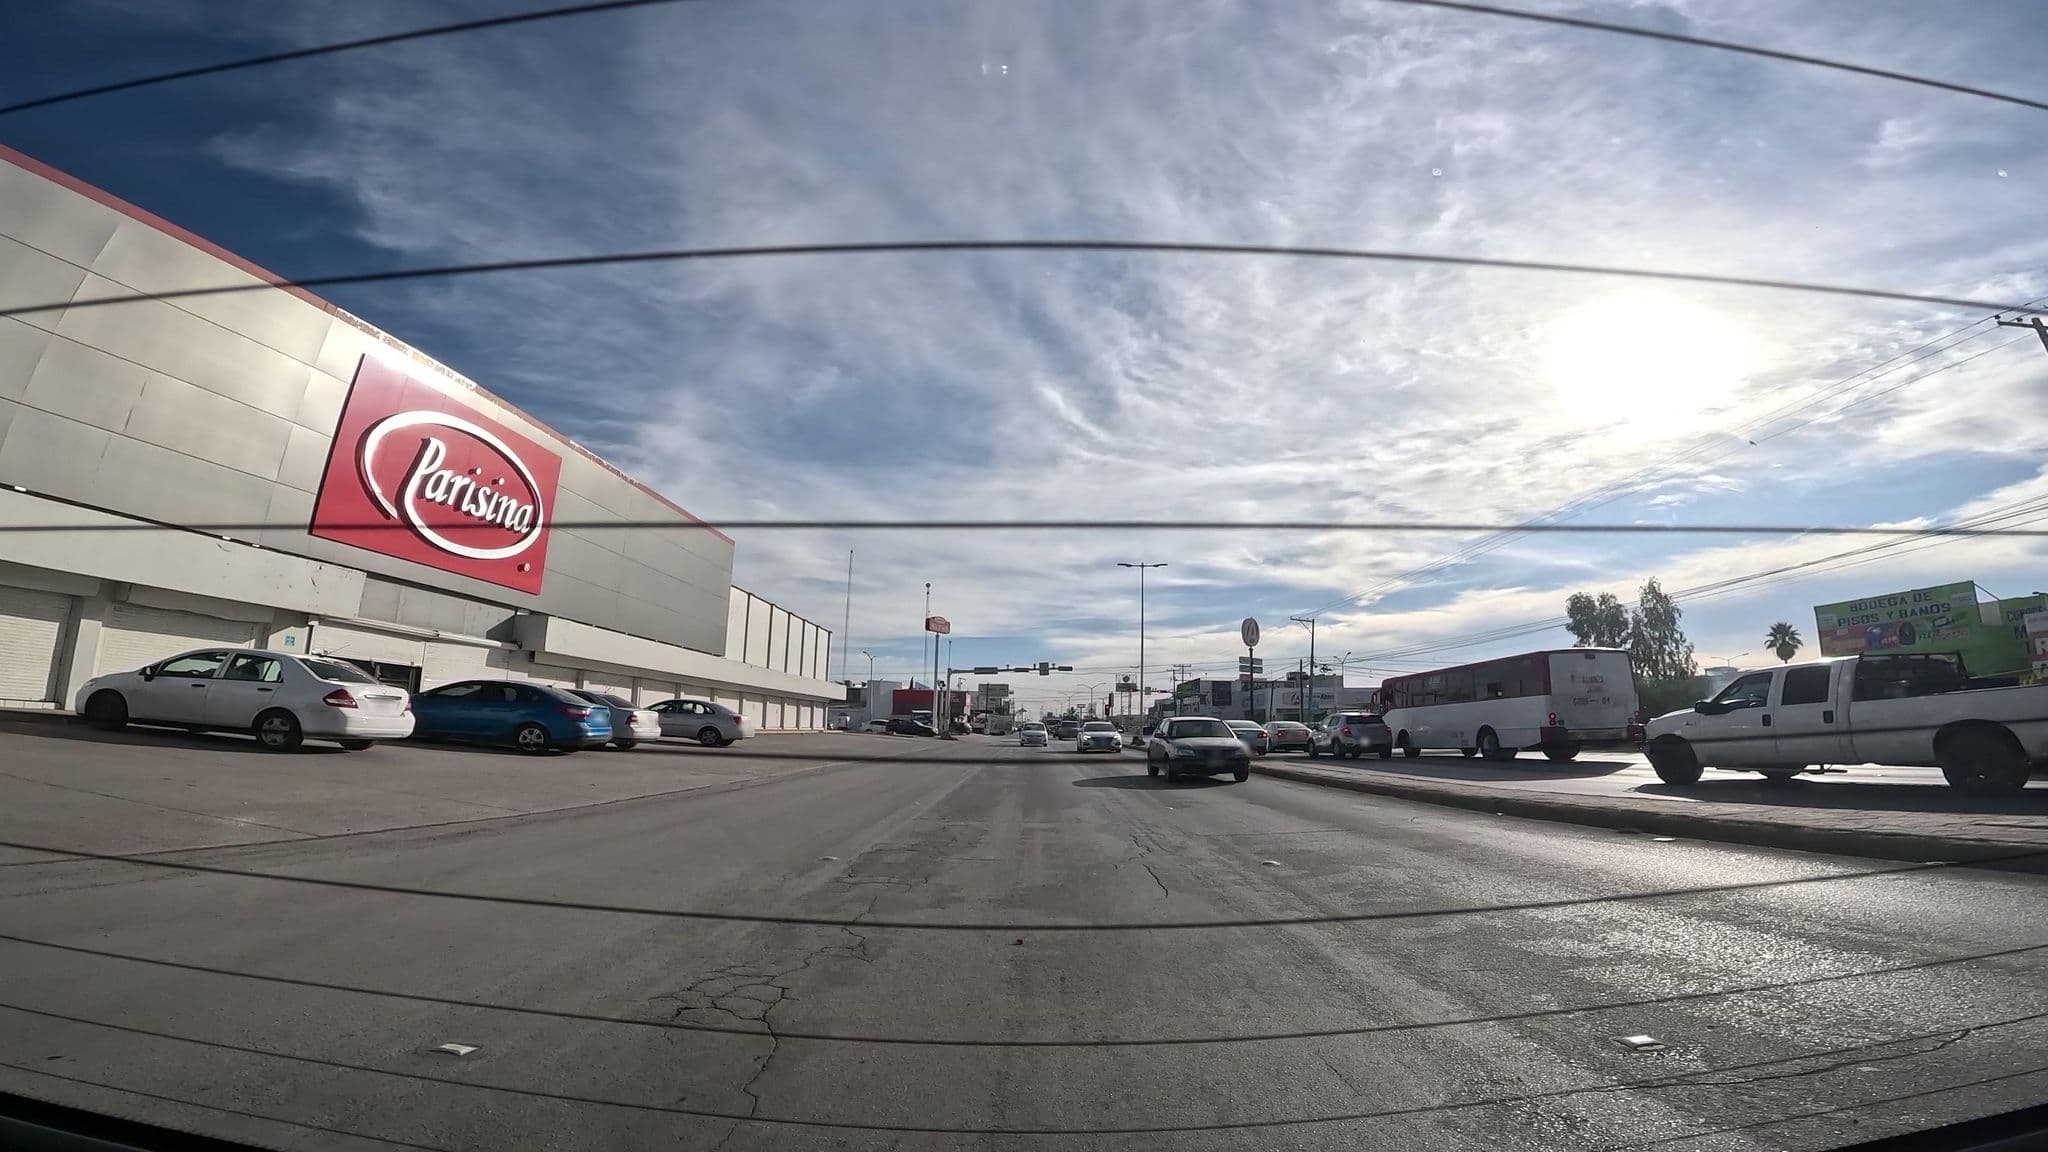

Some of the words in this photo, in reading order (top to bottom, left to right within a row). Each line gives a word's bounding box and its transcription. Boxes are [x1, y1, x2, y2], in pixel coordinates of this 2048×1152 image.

[404, 437, 533, 534] Parisina
[1849, 595, 1908, 612] BODEGA
[1913, 591, 1933, 602] DE
[1838, 613, 1880, 627] PISOS
[1886, 611, 1894, 620] Y
